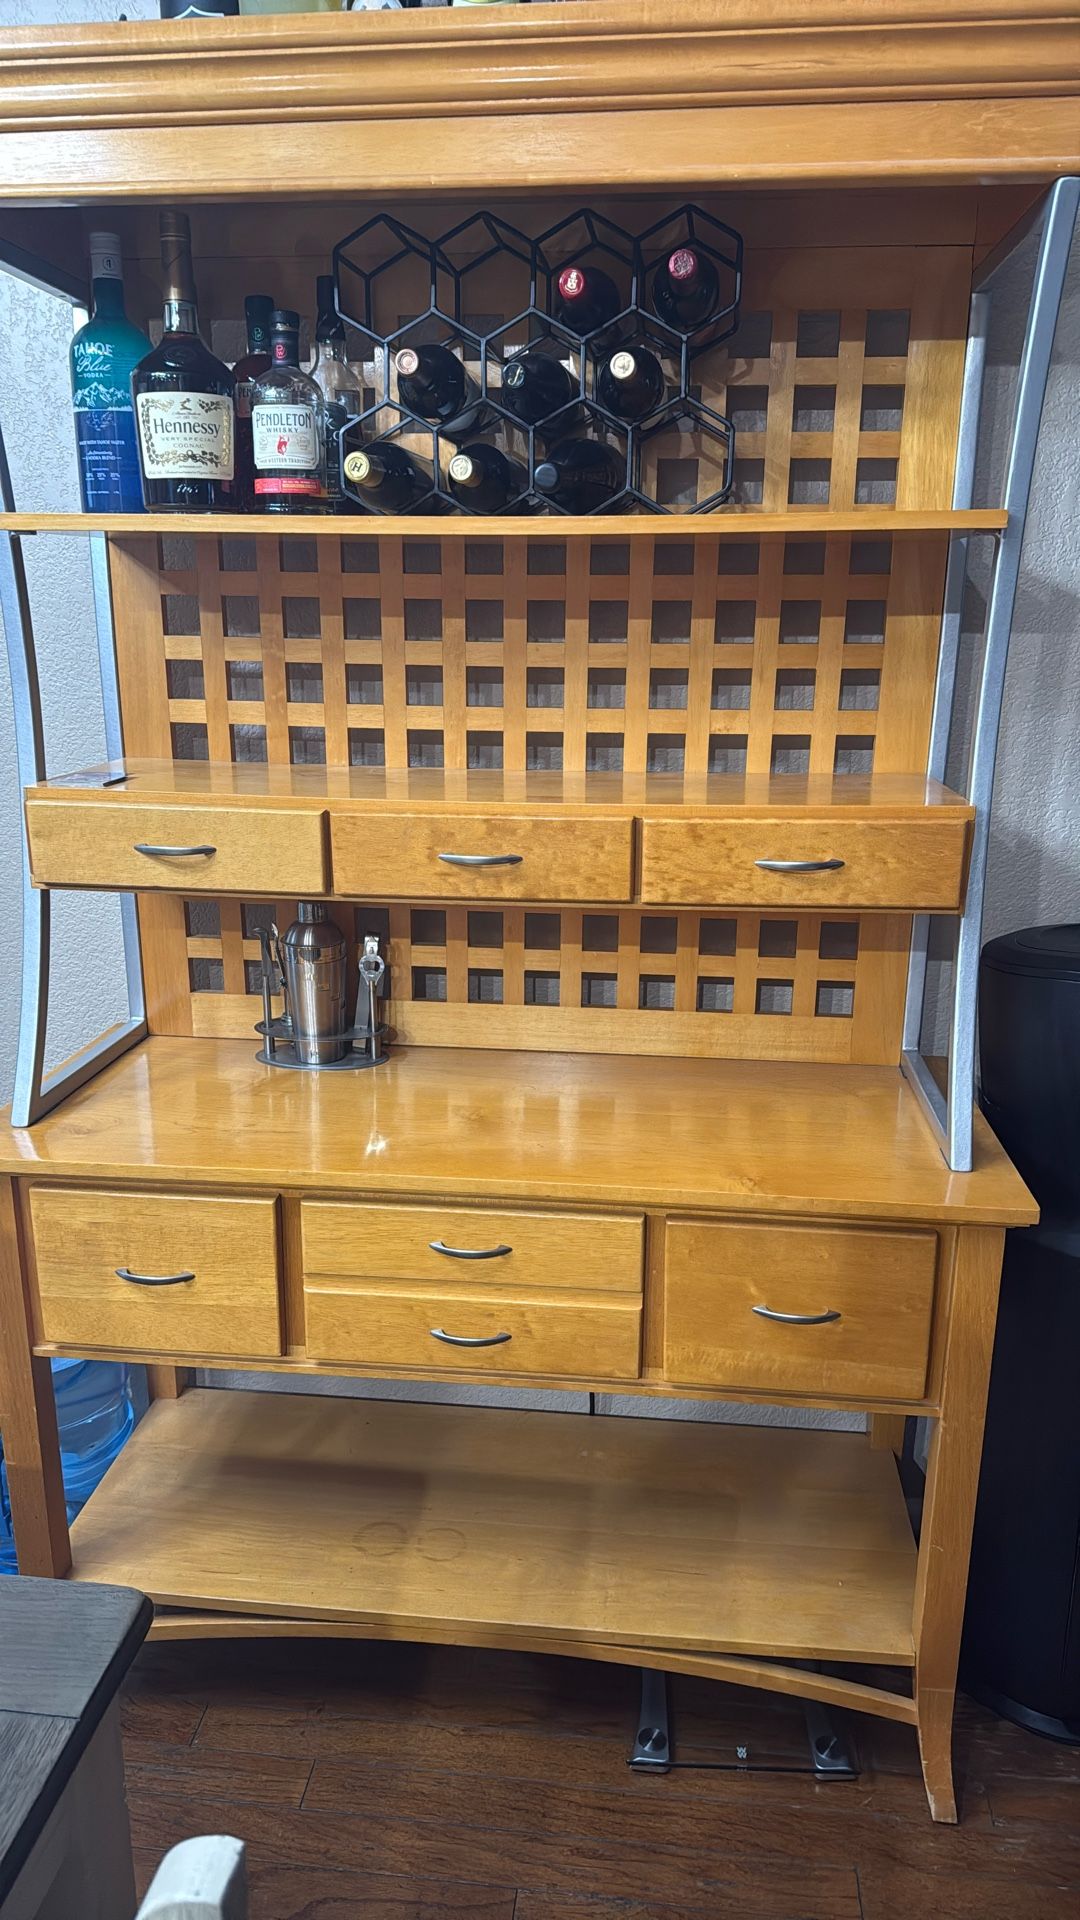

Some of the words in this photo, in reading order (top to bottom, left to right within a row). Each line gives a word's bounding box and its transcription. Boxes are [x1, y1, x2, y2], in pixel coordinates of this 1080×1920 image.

[73, 342, 113, 358] TAHOE
[76, 355, 112, 372] Blue
[153, 417, 221, 438] Hennessy
[255, 411, 312, 429] PENDLETON
[351, 462, 363, 473] H
